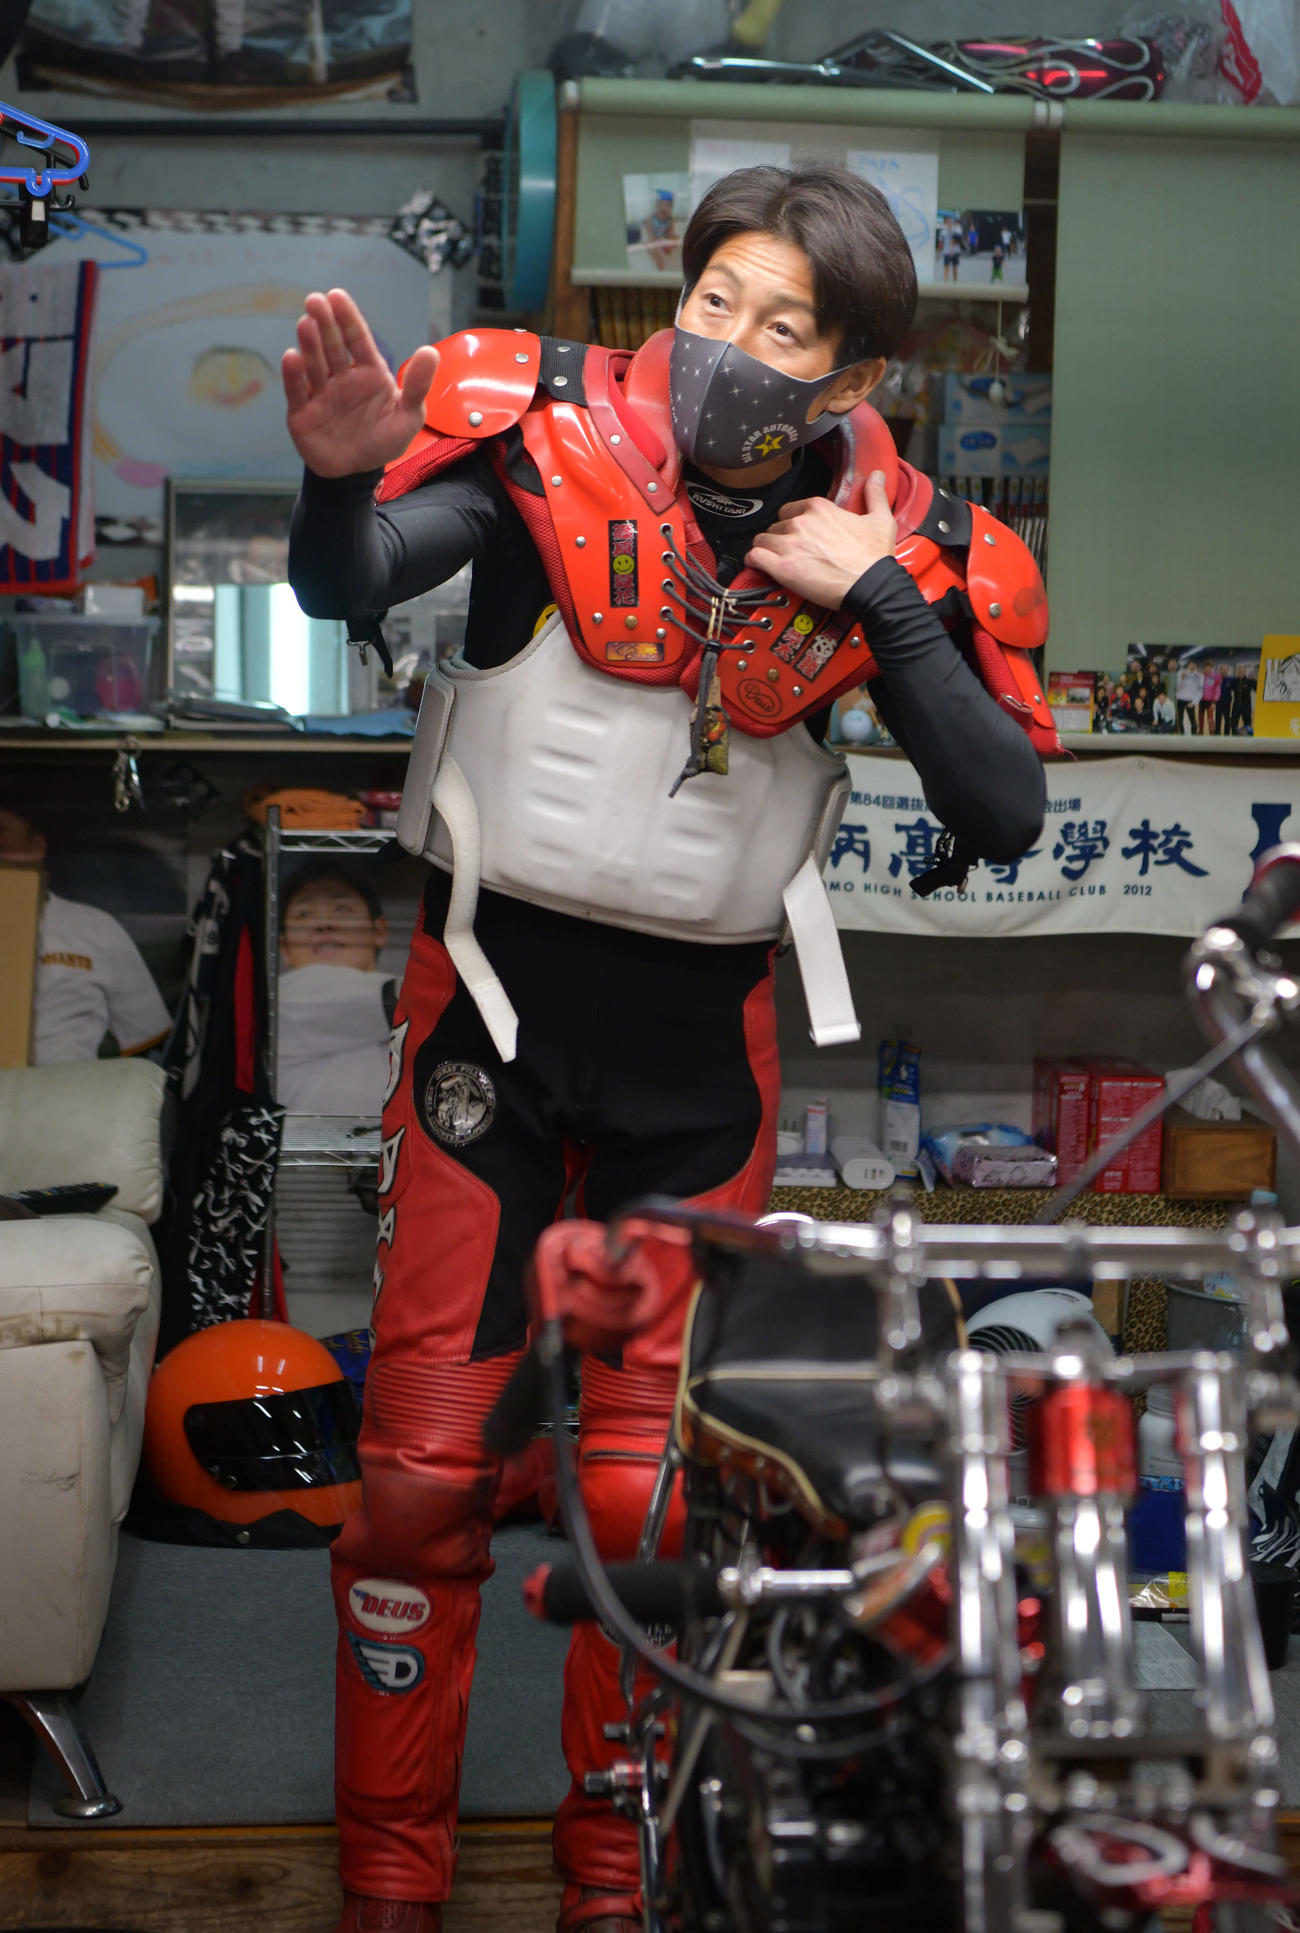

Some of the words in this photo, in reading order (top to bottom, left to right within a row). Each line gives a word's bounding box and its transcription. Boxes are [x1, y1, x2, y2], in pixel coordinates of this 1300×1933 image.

[850, 791, 930, 812] 第84回選抜
[828, 881, 855, 893] MO
[863, 883, 902, 897] HIGH
[910, 890, 976, 902] SHOOL
[986, 889, 1061, 902] BASEBALL
[1069, 884, 1107, 897] CLUB
[1123, 884, 1153, 897] 2012
[361, 1594, 427, 1622] DEUS
